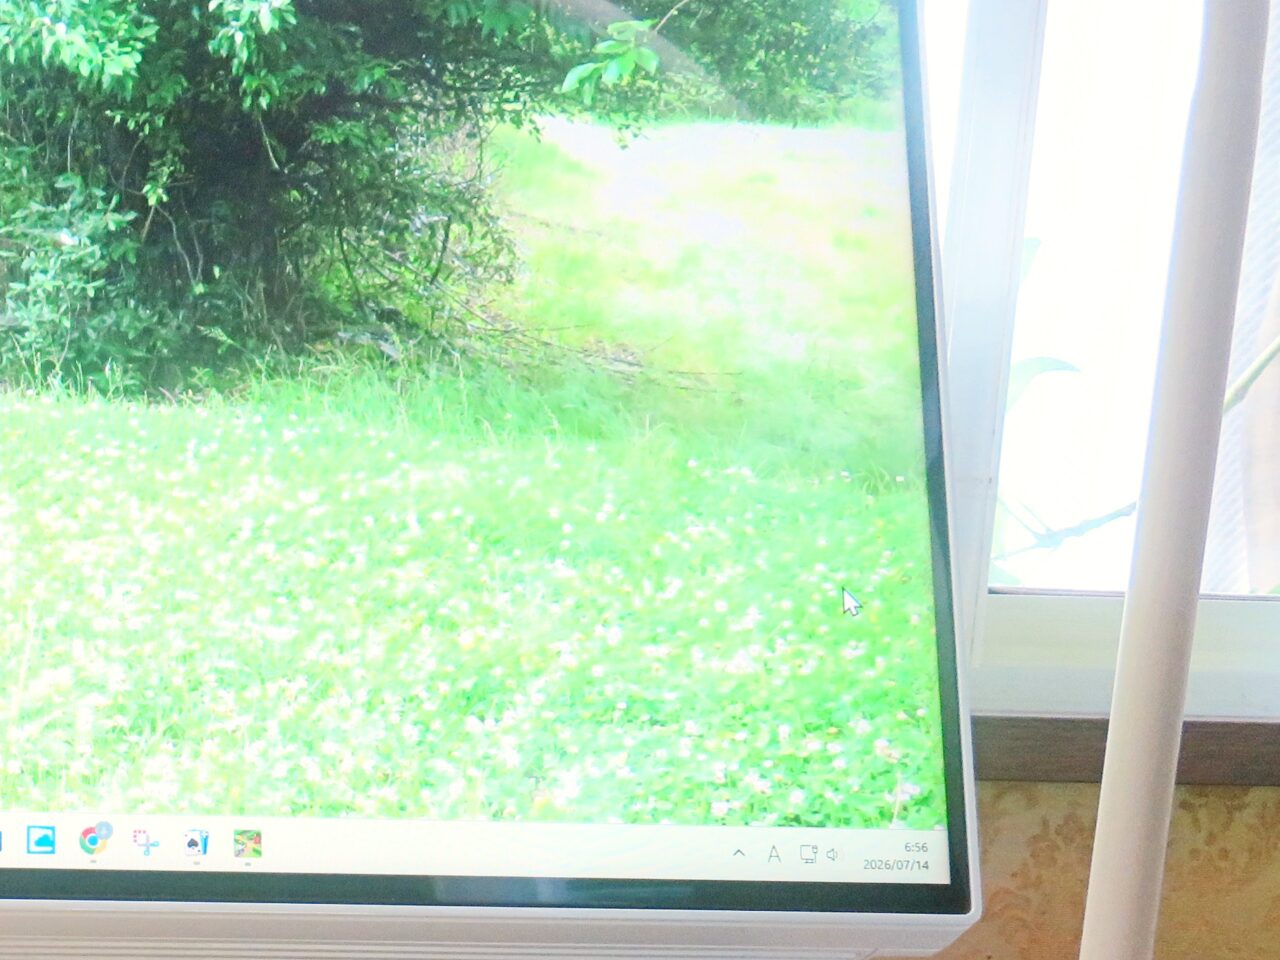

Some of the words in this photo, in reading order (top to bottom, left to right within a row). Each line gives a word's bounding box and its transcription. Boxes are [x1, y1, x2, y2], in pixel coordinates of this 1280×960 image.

[904, 842, 929, 853] 6:56
[767, 844, 782, 864] A
[863, 859, 929, 871] 2026/07/14
